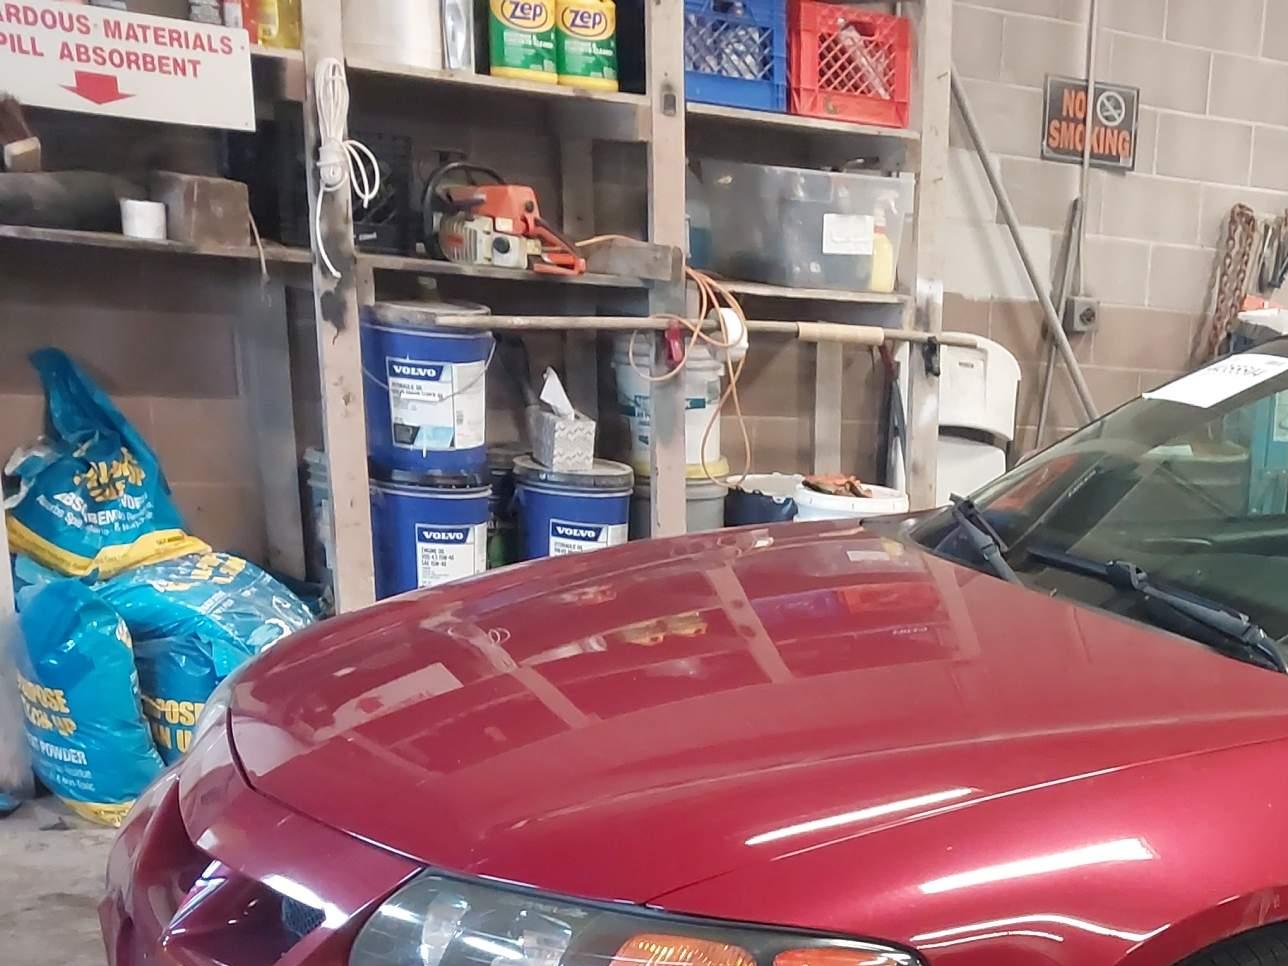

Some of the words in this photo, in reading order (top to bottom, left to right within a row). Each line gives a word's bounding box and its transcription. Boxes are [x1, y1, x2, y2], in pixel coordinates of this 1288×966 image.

[103, 18, 233, 55] MATERIALS
[60, 41, 201, 78] ABSORBENT
[1062, 87, 1086, 119] NO
[393, 365, 436, 377] VOLVO
[422, 531, 464, 540] VOLVO
[556, 526, 596, 538] VOLVO
[39, 740, 87, 766] POWDER
